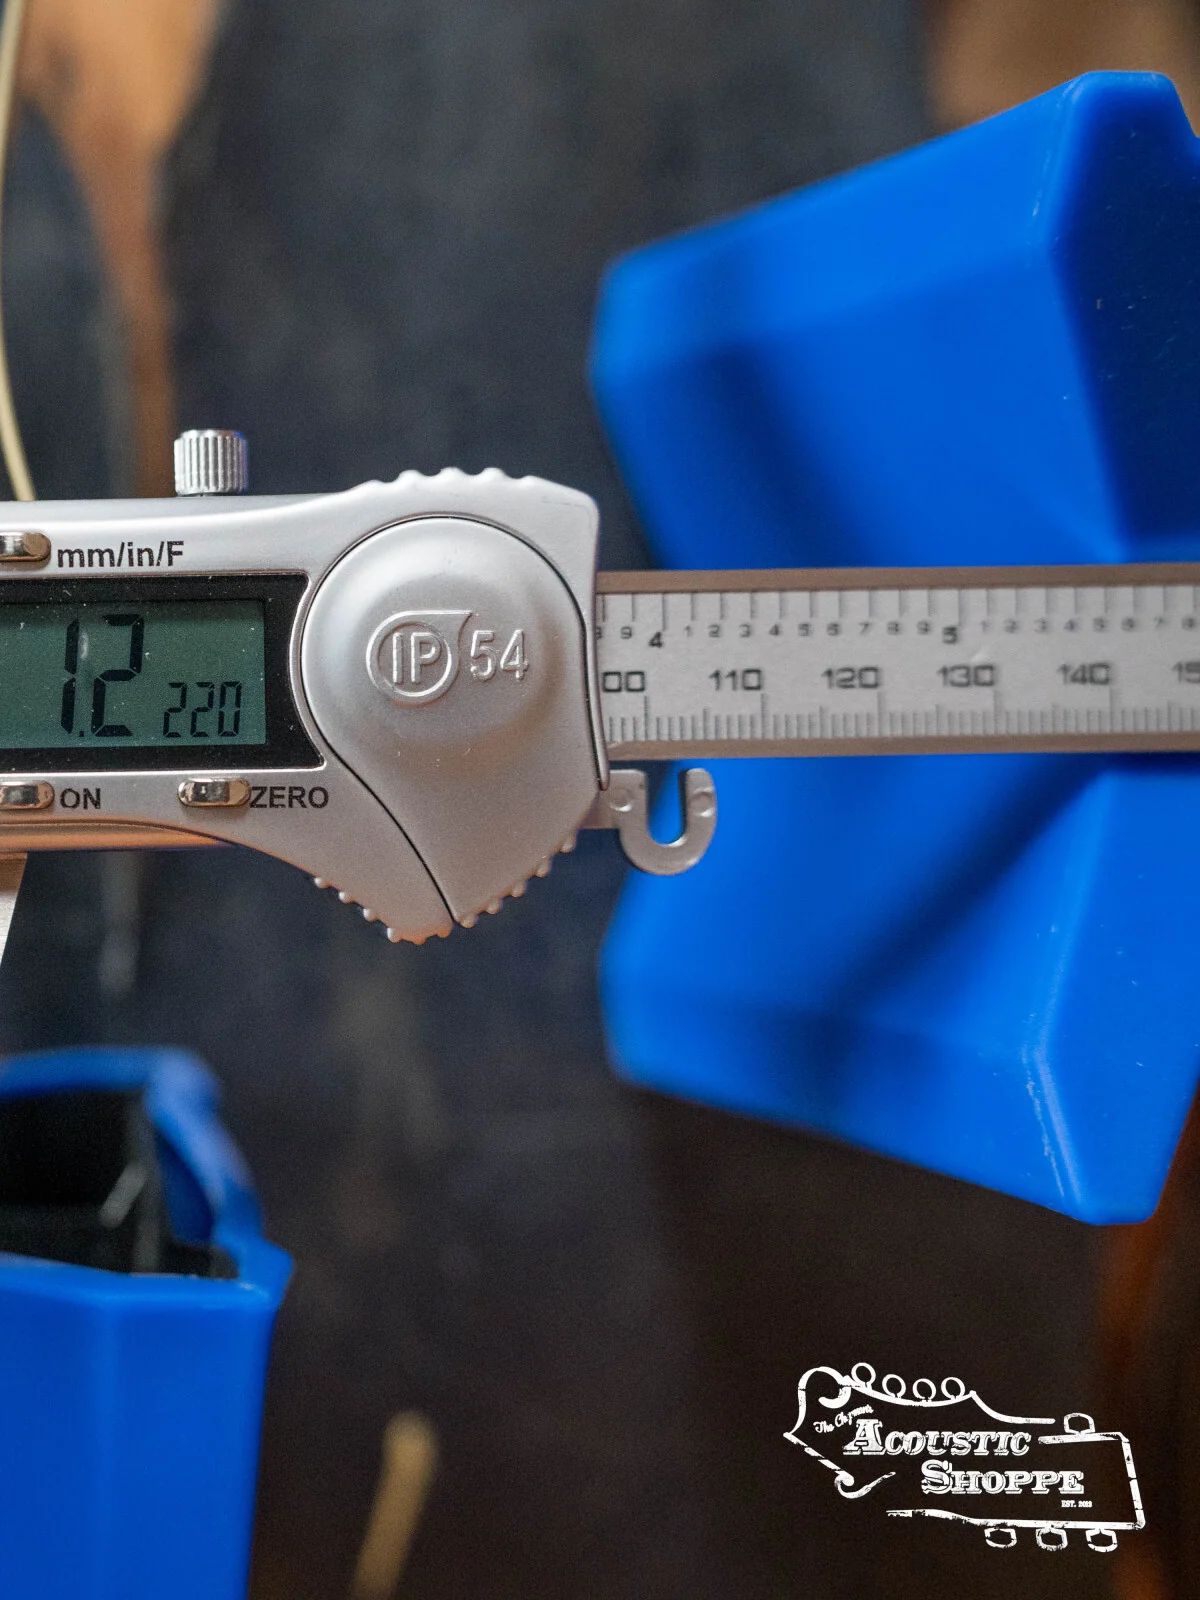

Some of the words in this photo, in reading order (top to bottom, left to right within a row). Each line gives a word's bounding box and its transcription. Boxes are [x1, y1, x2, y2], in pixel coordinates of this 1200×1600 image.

[56, 540, 185, 568] mm/in/F
[648, 631, 663, 648] 4
[708, 625, 722, 638] 2
[392, 632, 442, 685] IP
[470, 629, 530, 682] 54
[601, 671, 646, 692] 00
[709, 668, 762, 691] 110
[822, 666, 880, 690] 120
[937, 664, 996, 687] 130
[1057, 662, 1112, 685] 140
[60, 787, 100, 810] ON
[250, 786, 330, 809] ZERO
